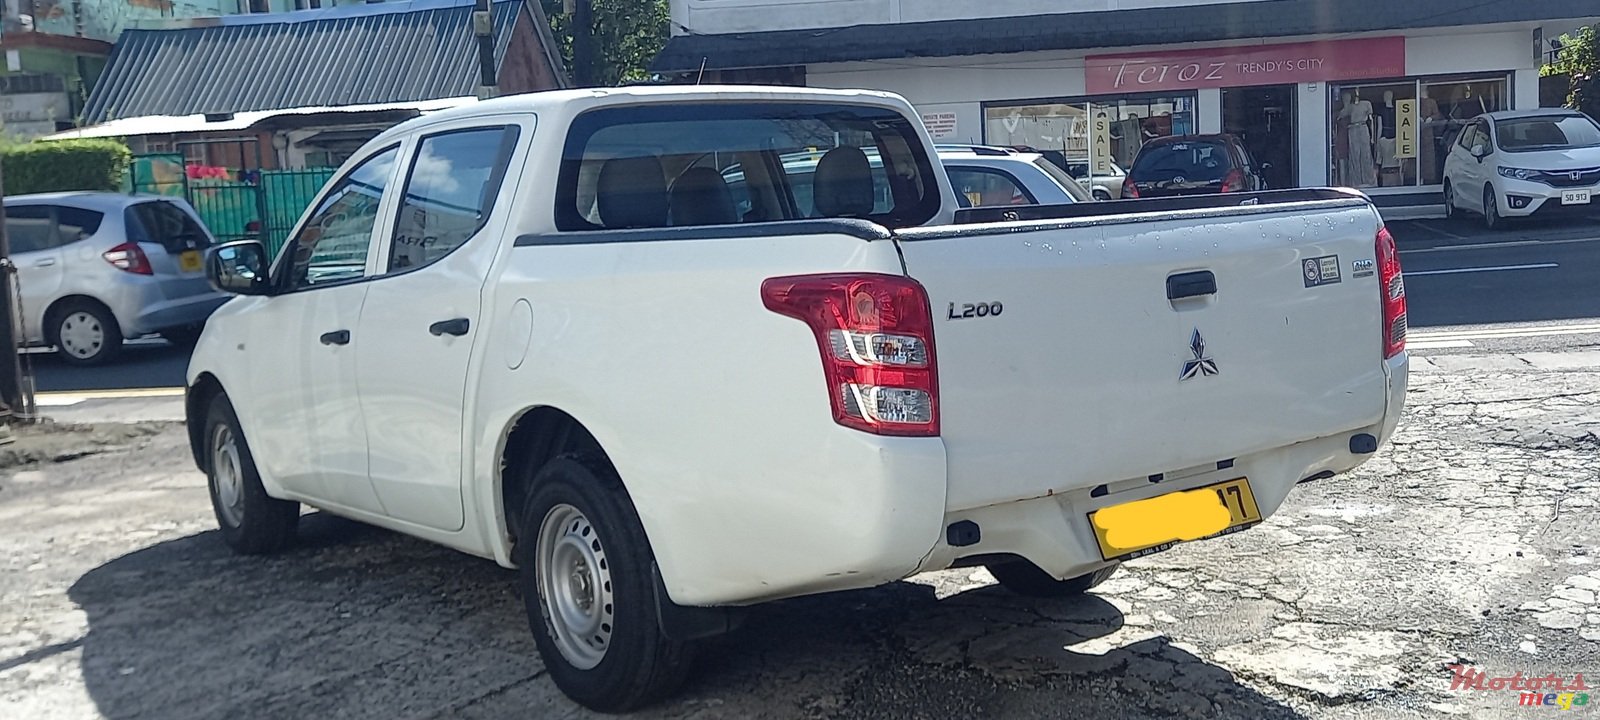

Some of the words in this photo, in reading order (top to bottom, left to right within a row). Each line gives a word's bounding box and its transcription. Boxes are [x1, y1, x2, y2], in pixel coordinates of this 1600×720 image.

[1236, 60, 1294, 73] TRENDY'S
[1297, 58, 1324, 70] CITY
[1096, 121, 1105, 170] SALE
[1401, 103, 1411, 154] SALE
[946, 301, 1003, 320] L200
